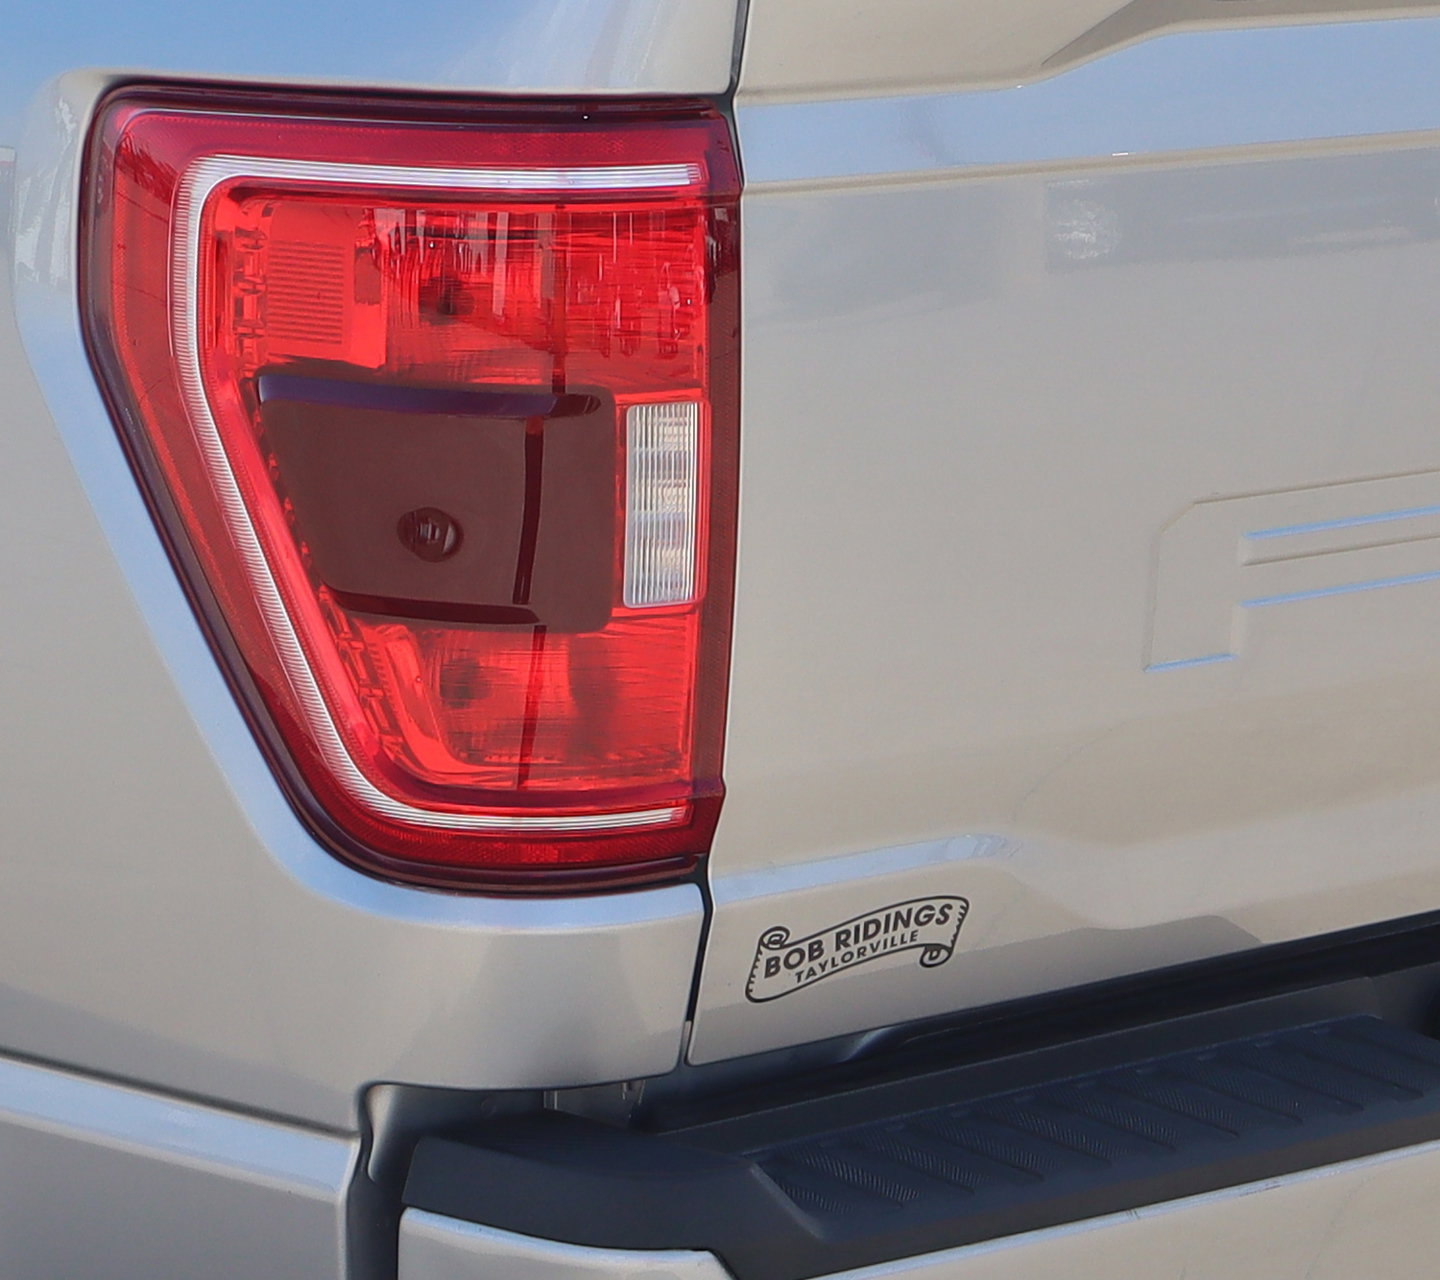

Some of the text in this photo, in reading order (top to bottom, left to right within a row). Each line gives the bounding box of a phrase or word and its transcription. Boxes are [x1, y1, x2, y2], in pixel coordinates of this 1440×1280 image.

[764, 903, 953, 979] BOB RIDINGS
[795, 930, 919, 983] TAYLORVILLE
